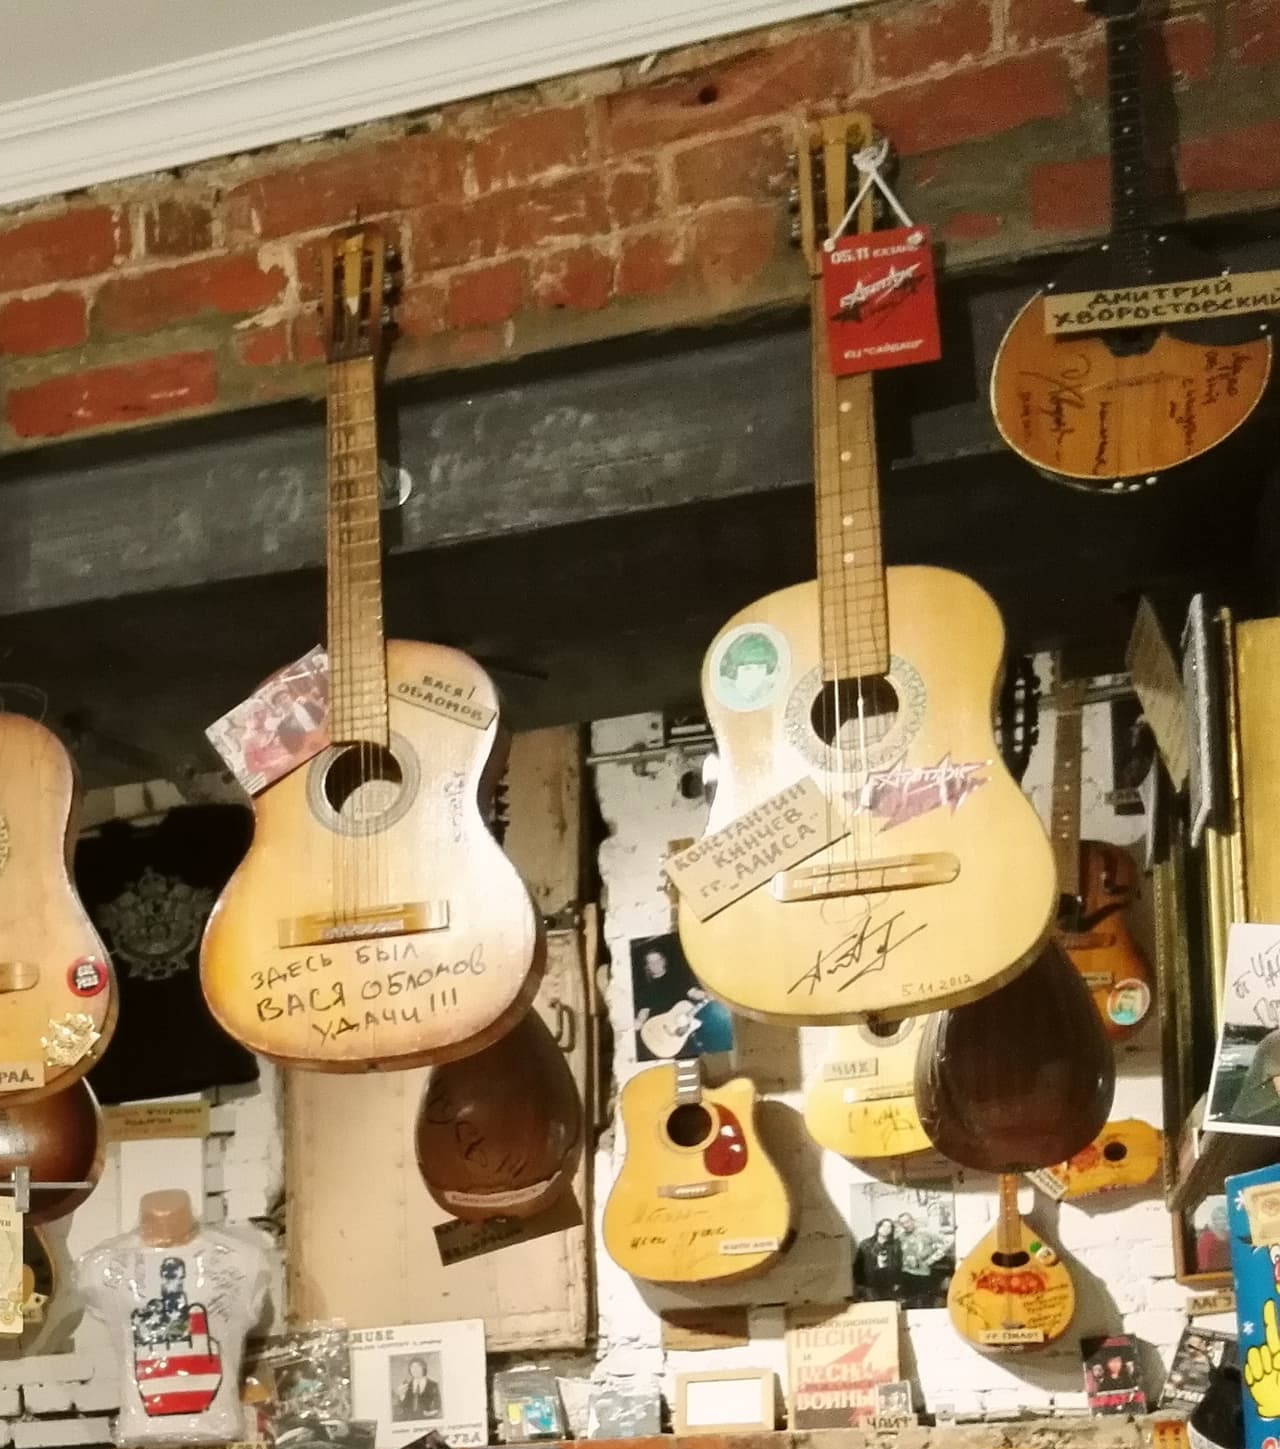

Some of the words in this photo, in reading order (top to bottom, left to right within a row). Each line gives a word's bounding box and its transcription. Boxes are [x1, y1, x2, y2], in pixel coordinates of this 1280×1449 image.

[1090, 280, 1233, 308] ДМИТРИЙ
[397, 684, 484, 721] ОБЛОМОВ
[673, 785, 807, 871] КОНСТАНТИН
[712, 810, 801, 867] КИНЧЕВ
[250, 953, 333, 990] ЗДЕСЬ
[356, 942, 419, 964] БЫЛ
[257, 981, 346, 1022] ВАСЯ
[361, 943, 487, 1000] ОБЛОМОВ
